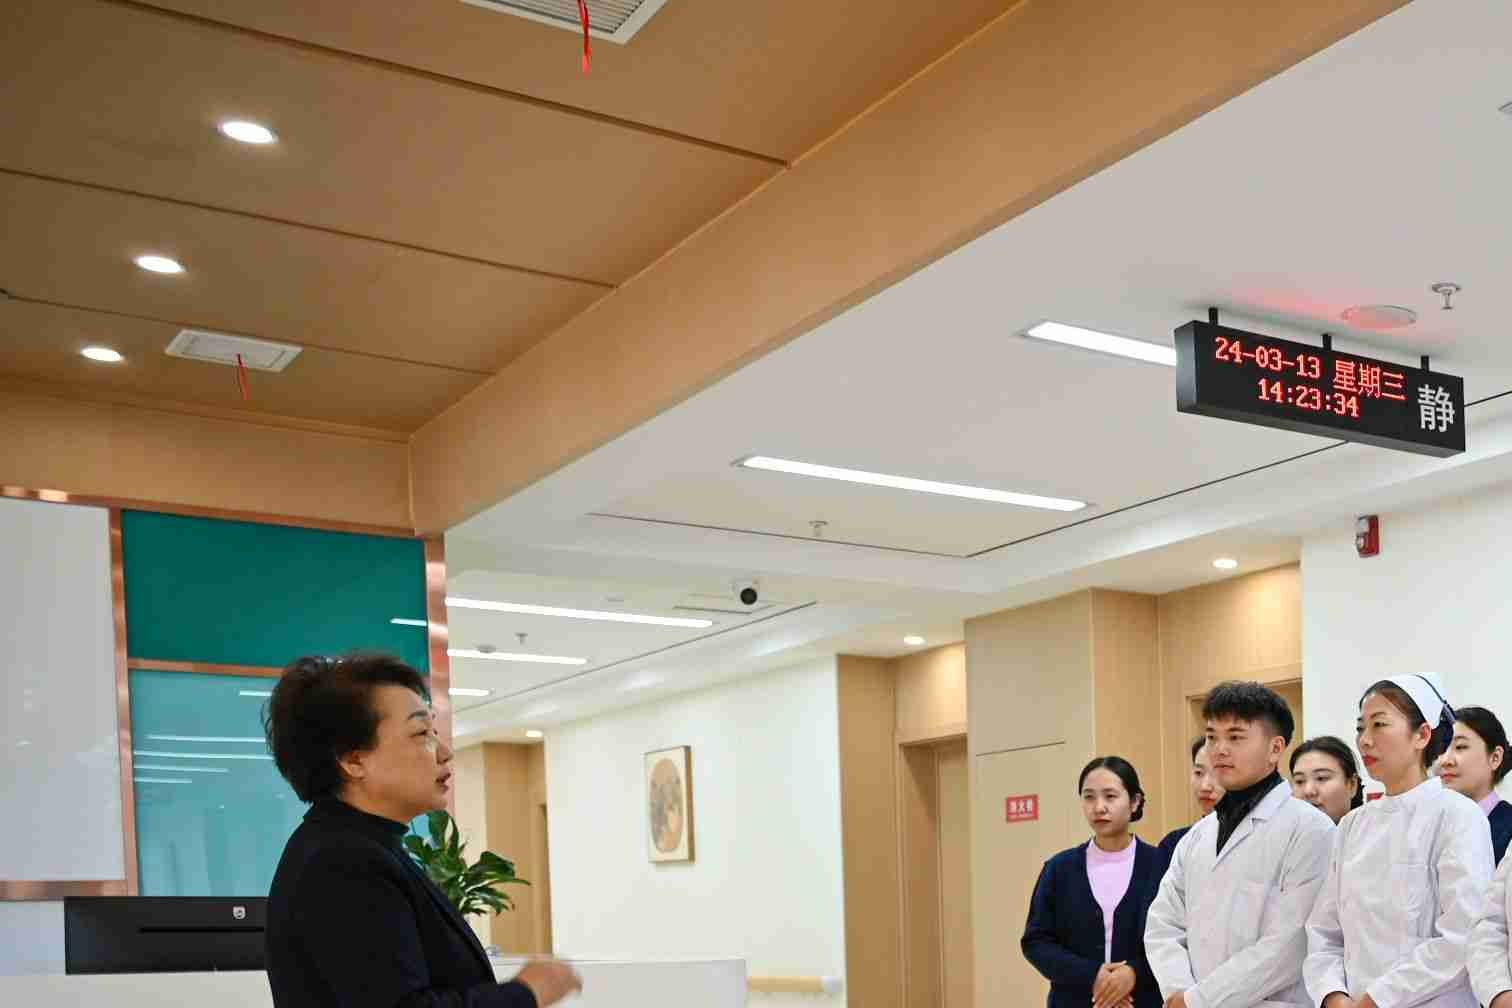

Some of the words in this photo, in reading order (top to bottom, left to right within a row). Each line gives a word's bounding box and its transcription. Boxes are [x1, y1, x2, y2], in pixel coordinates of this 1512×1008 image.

[1214, 336, 1321, 380] 24-03-13
[1332, 358, 1407, 401] 星期三
[1257, 377, 1361, 418] 14:23:34
[1417, 383, 1456, 433] 静
